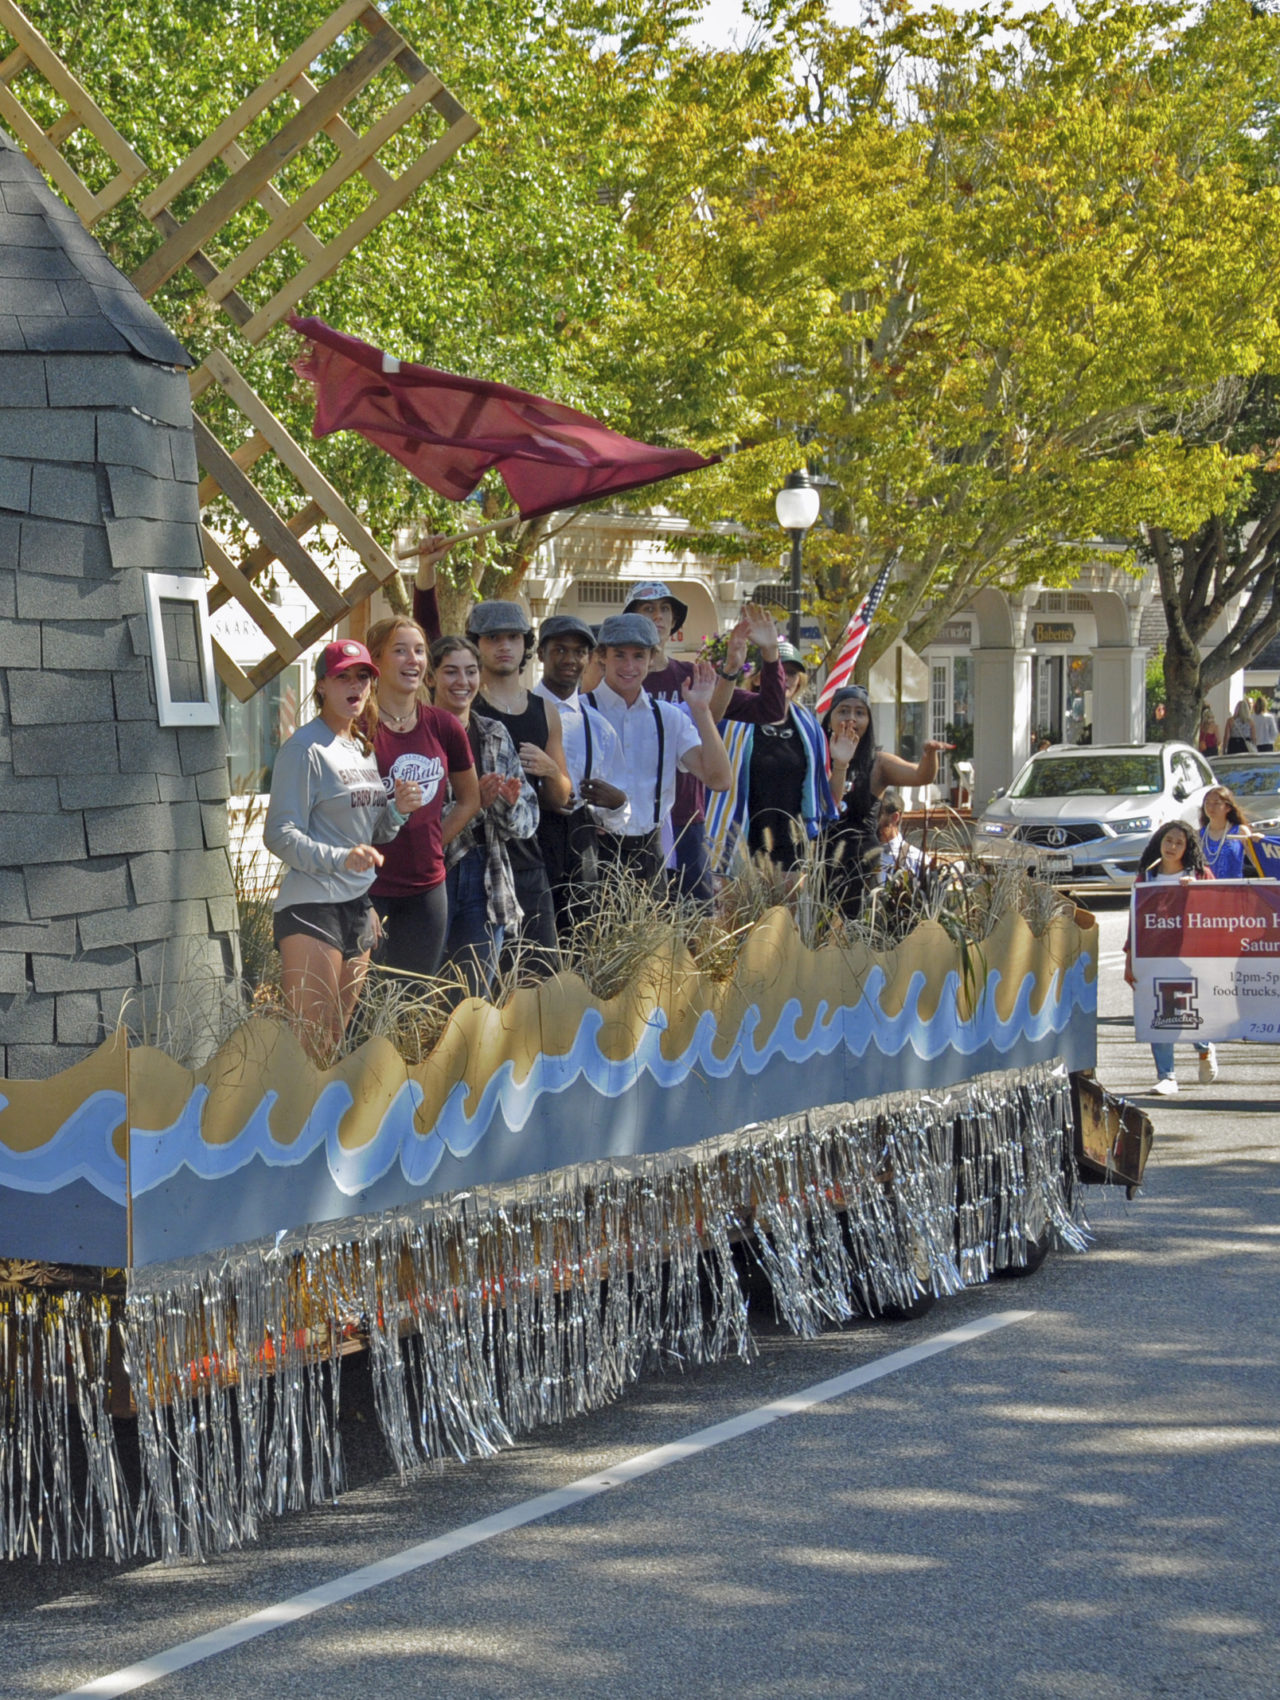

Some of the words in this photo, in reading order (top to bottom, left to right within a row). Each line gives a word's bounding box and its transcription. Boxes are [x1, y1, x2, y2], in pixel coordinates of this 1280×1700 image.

[1144, 913, 1182, 929] East
[1187, 912, 1267, 932] Hampton
[1213, 985, 1239, 996] food
[1242, 985, 1280, 998] trucks,
[1249, 1023, 1274, 1033] 7:30
